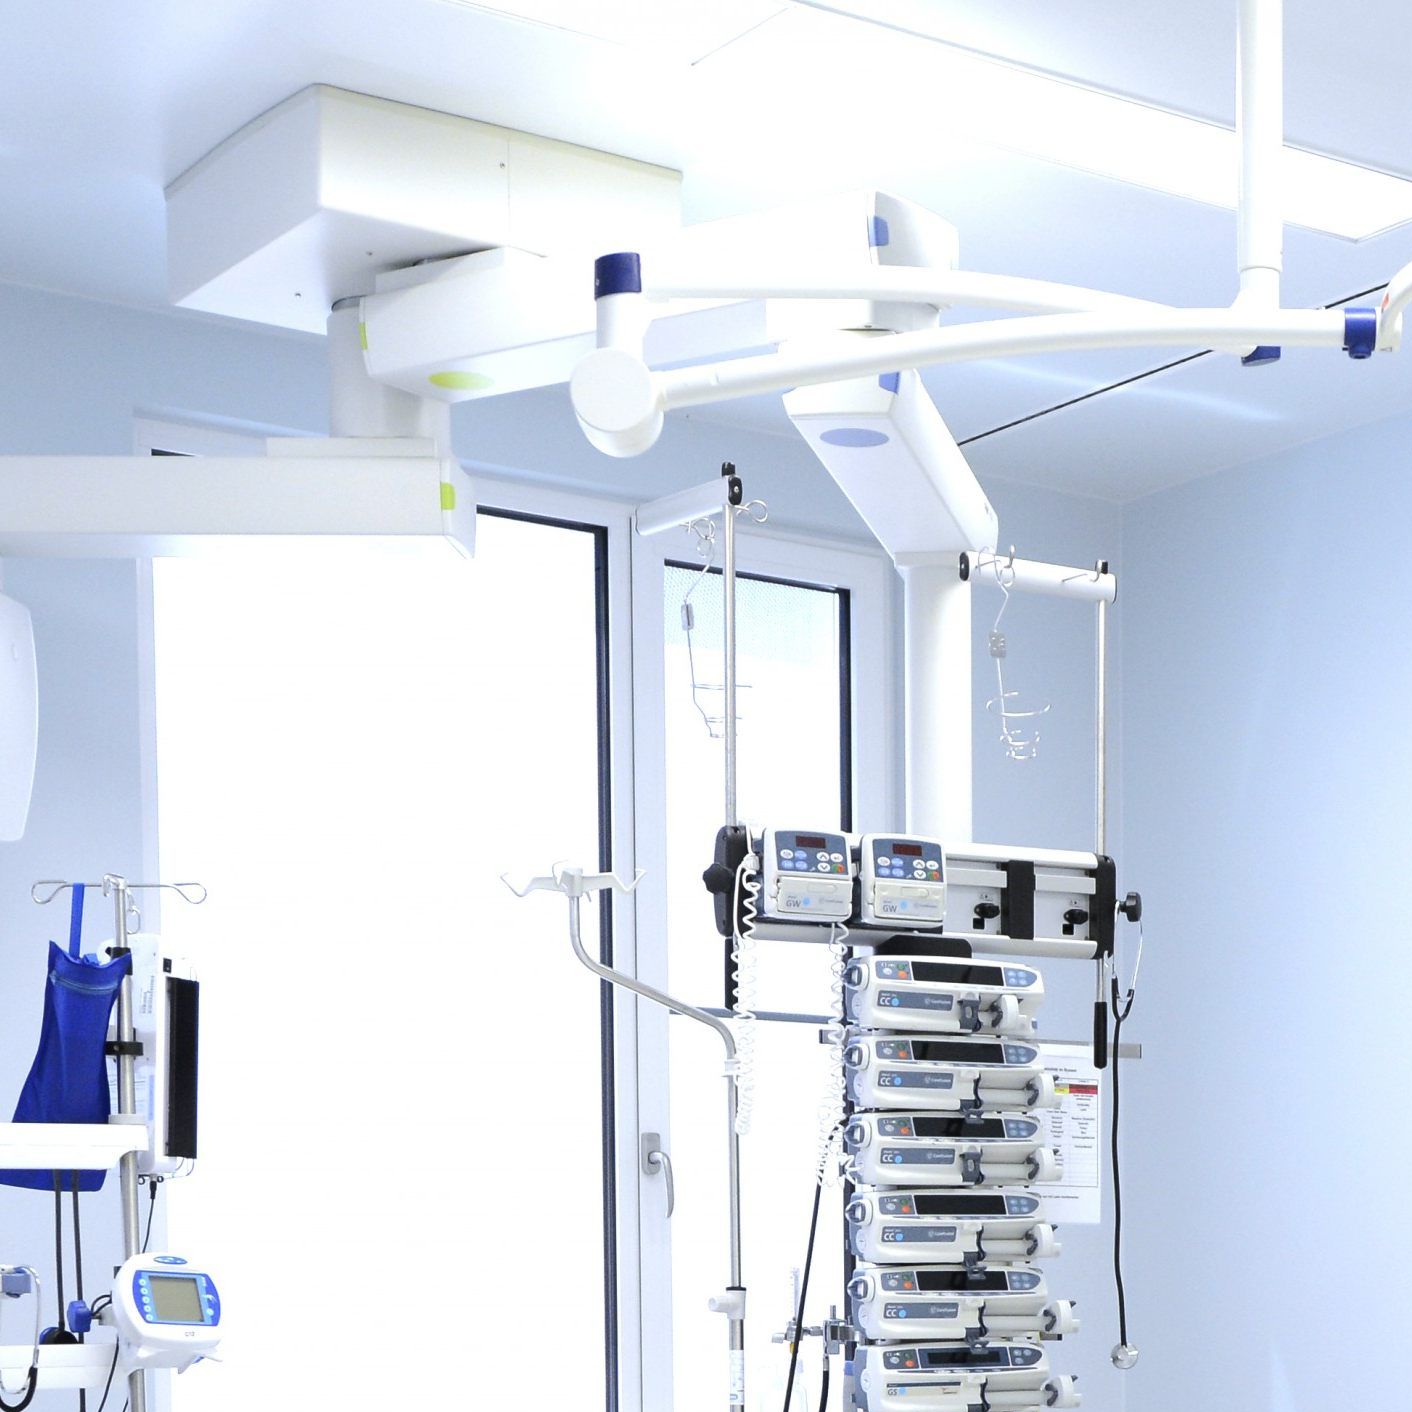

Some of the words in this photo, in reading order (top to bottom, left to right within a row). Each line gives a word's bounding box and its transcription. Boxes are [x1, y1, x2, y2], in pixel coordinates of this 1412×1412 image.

[786, 899, 800, 908] GW
[883, 904, 897, 913] GW
[879, 997, 891, 1006] CC
[879, 1077, 891, 1086] CC
[882, 1154, 893, 1163] CC
[883, 1232, 894, 1241] CC
[885, 1309, 896, 1318] CC
[887, 1388, 898, 1396] GS
